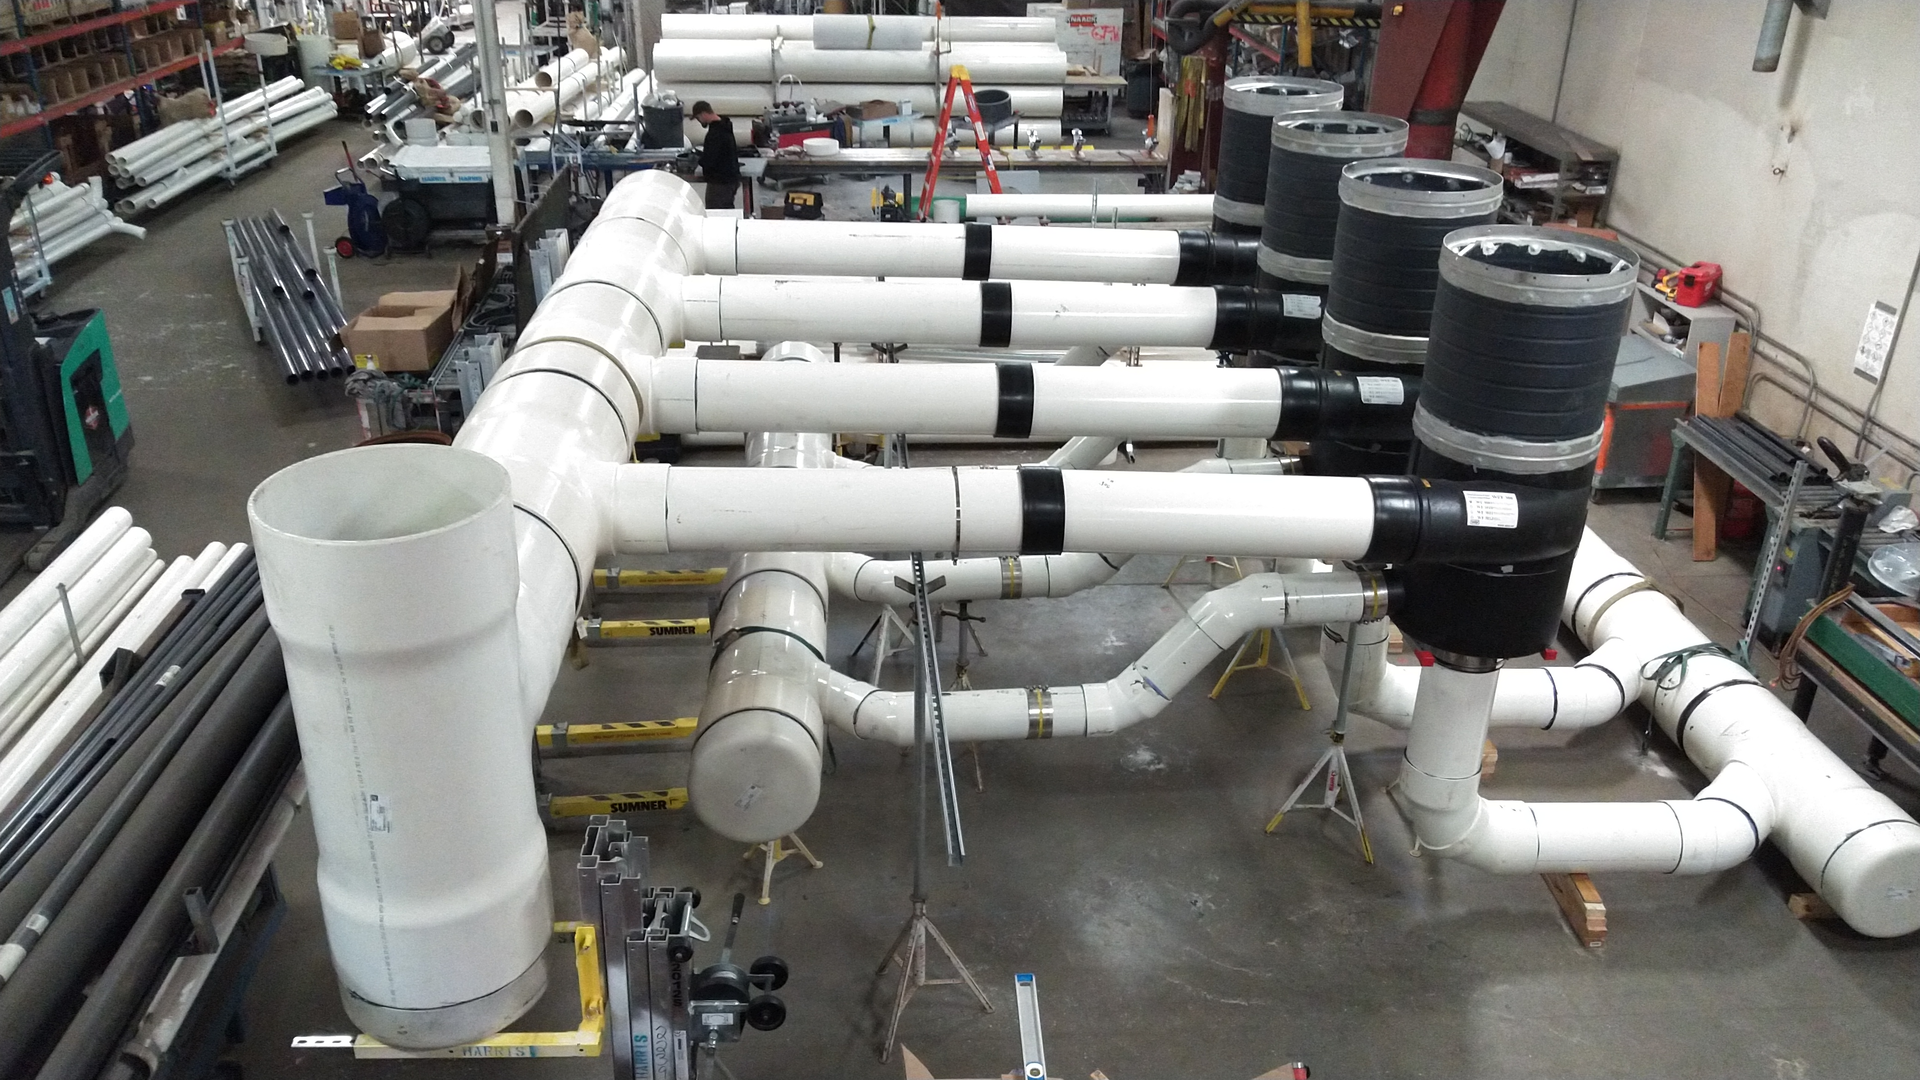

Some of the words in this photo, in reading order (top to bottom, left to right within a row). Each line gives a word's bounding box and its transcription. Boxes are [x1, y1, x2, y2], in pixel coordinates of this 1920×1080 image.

[649, 625, 696, 636] SUMNER
[610, 799, 668, 813] SUMNER
[462, 1045, 526, 1057] HARRIS
[633, 1034, 649, 1079] HARRIS
